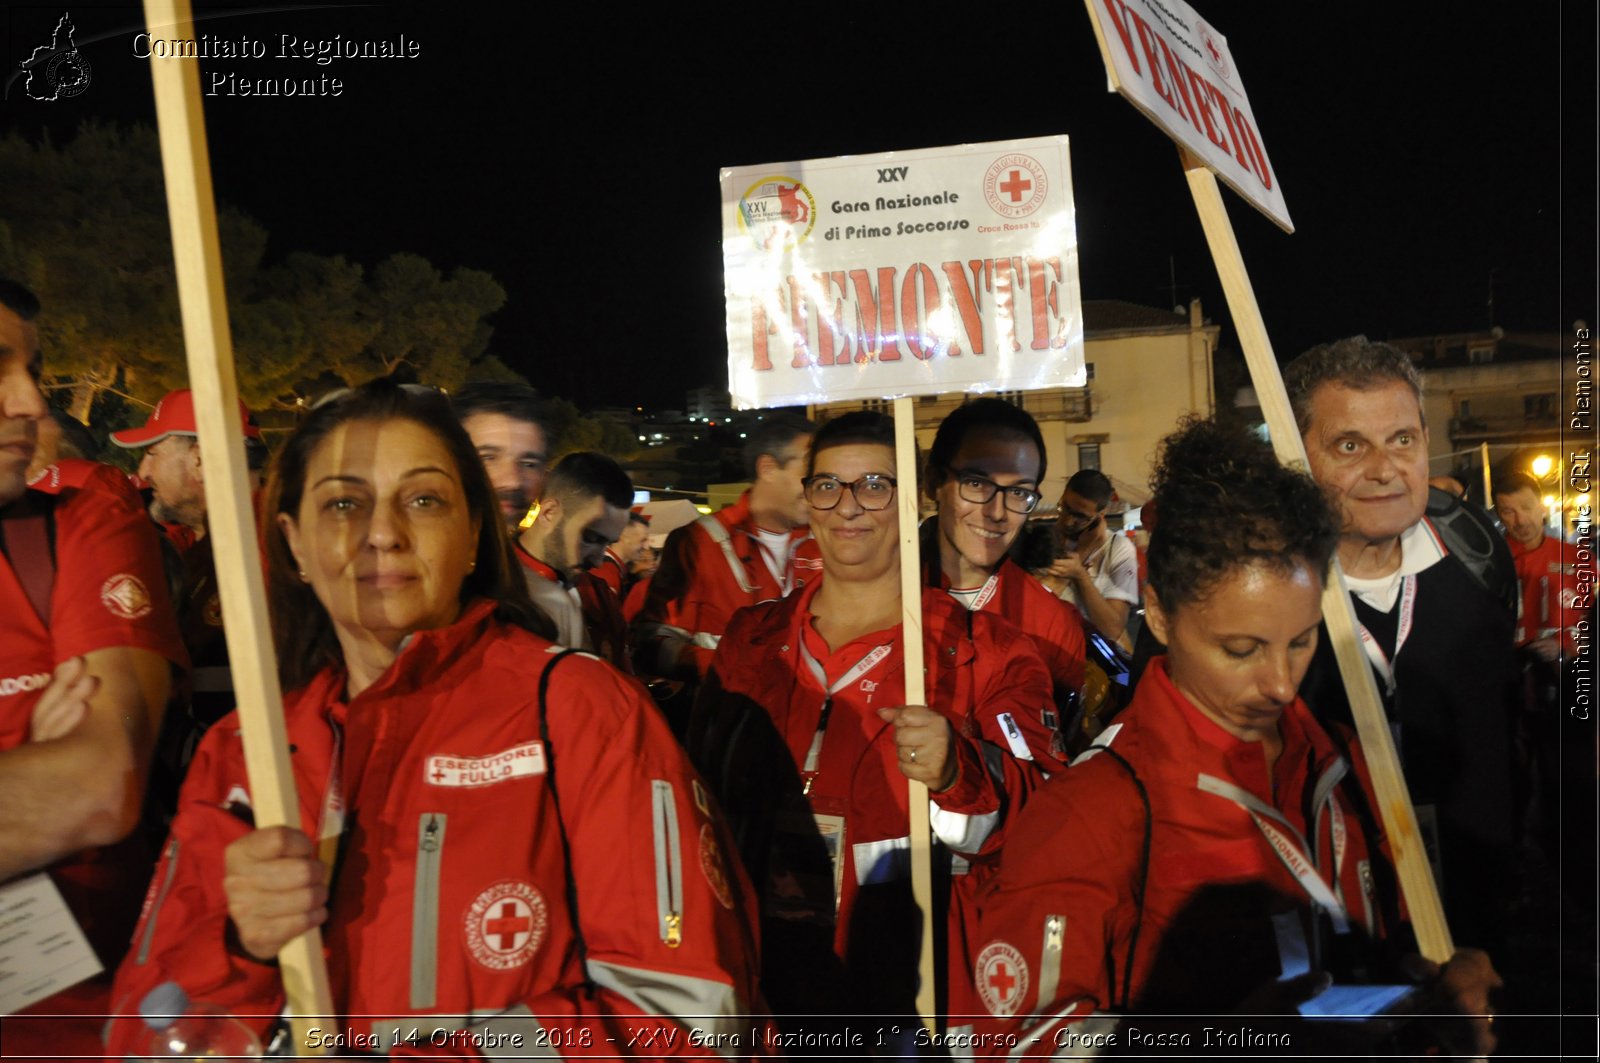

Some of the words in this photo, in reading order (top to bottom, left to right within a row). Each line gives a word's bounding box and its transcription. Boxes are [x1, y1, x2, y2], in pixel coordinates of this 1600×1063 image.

[1102, 0, 1272, 190] VENETO
[877, 166, 909, 184] XXV
[747, 201, 768, 214] XXV
[831, 200, 870, 214] Gara
[875, 190, 960, 211] Nazionale
[824, 227, 840, 241] di
[845, 225, 892, 240] Primo
[896, 219, 970, 236] Soccorso
[977, 225, 1001, 233] Croce
[1003, 223, 1029, 231] Rossa
[434, 747, 539, 770] ESECUTORE
